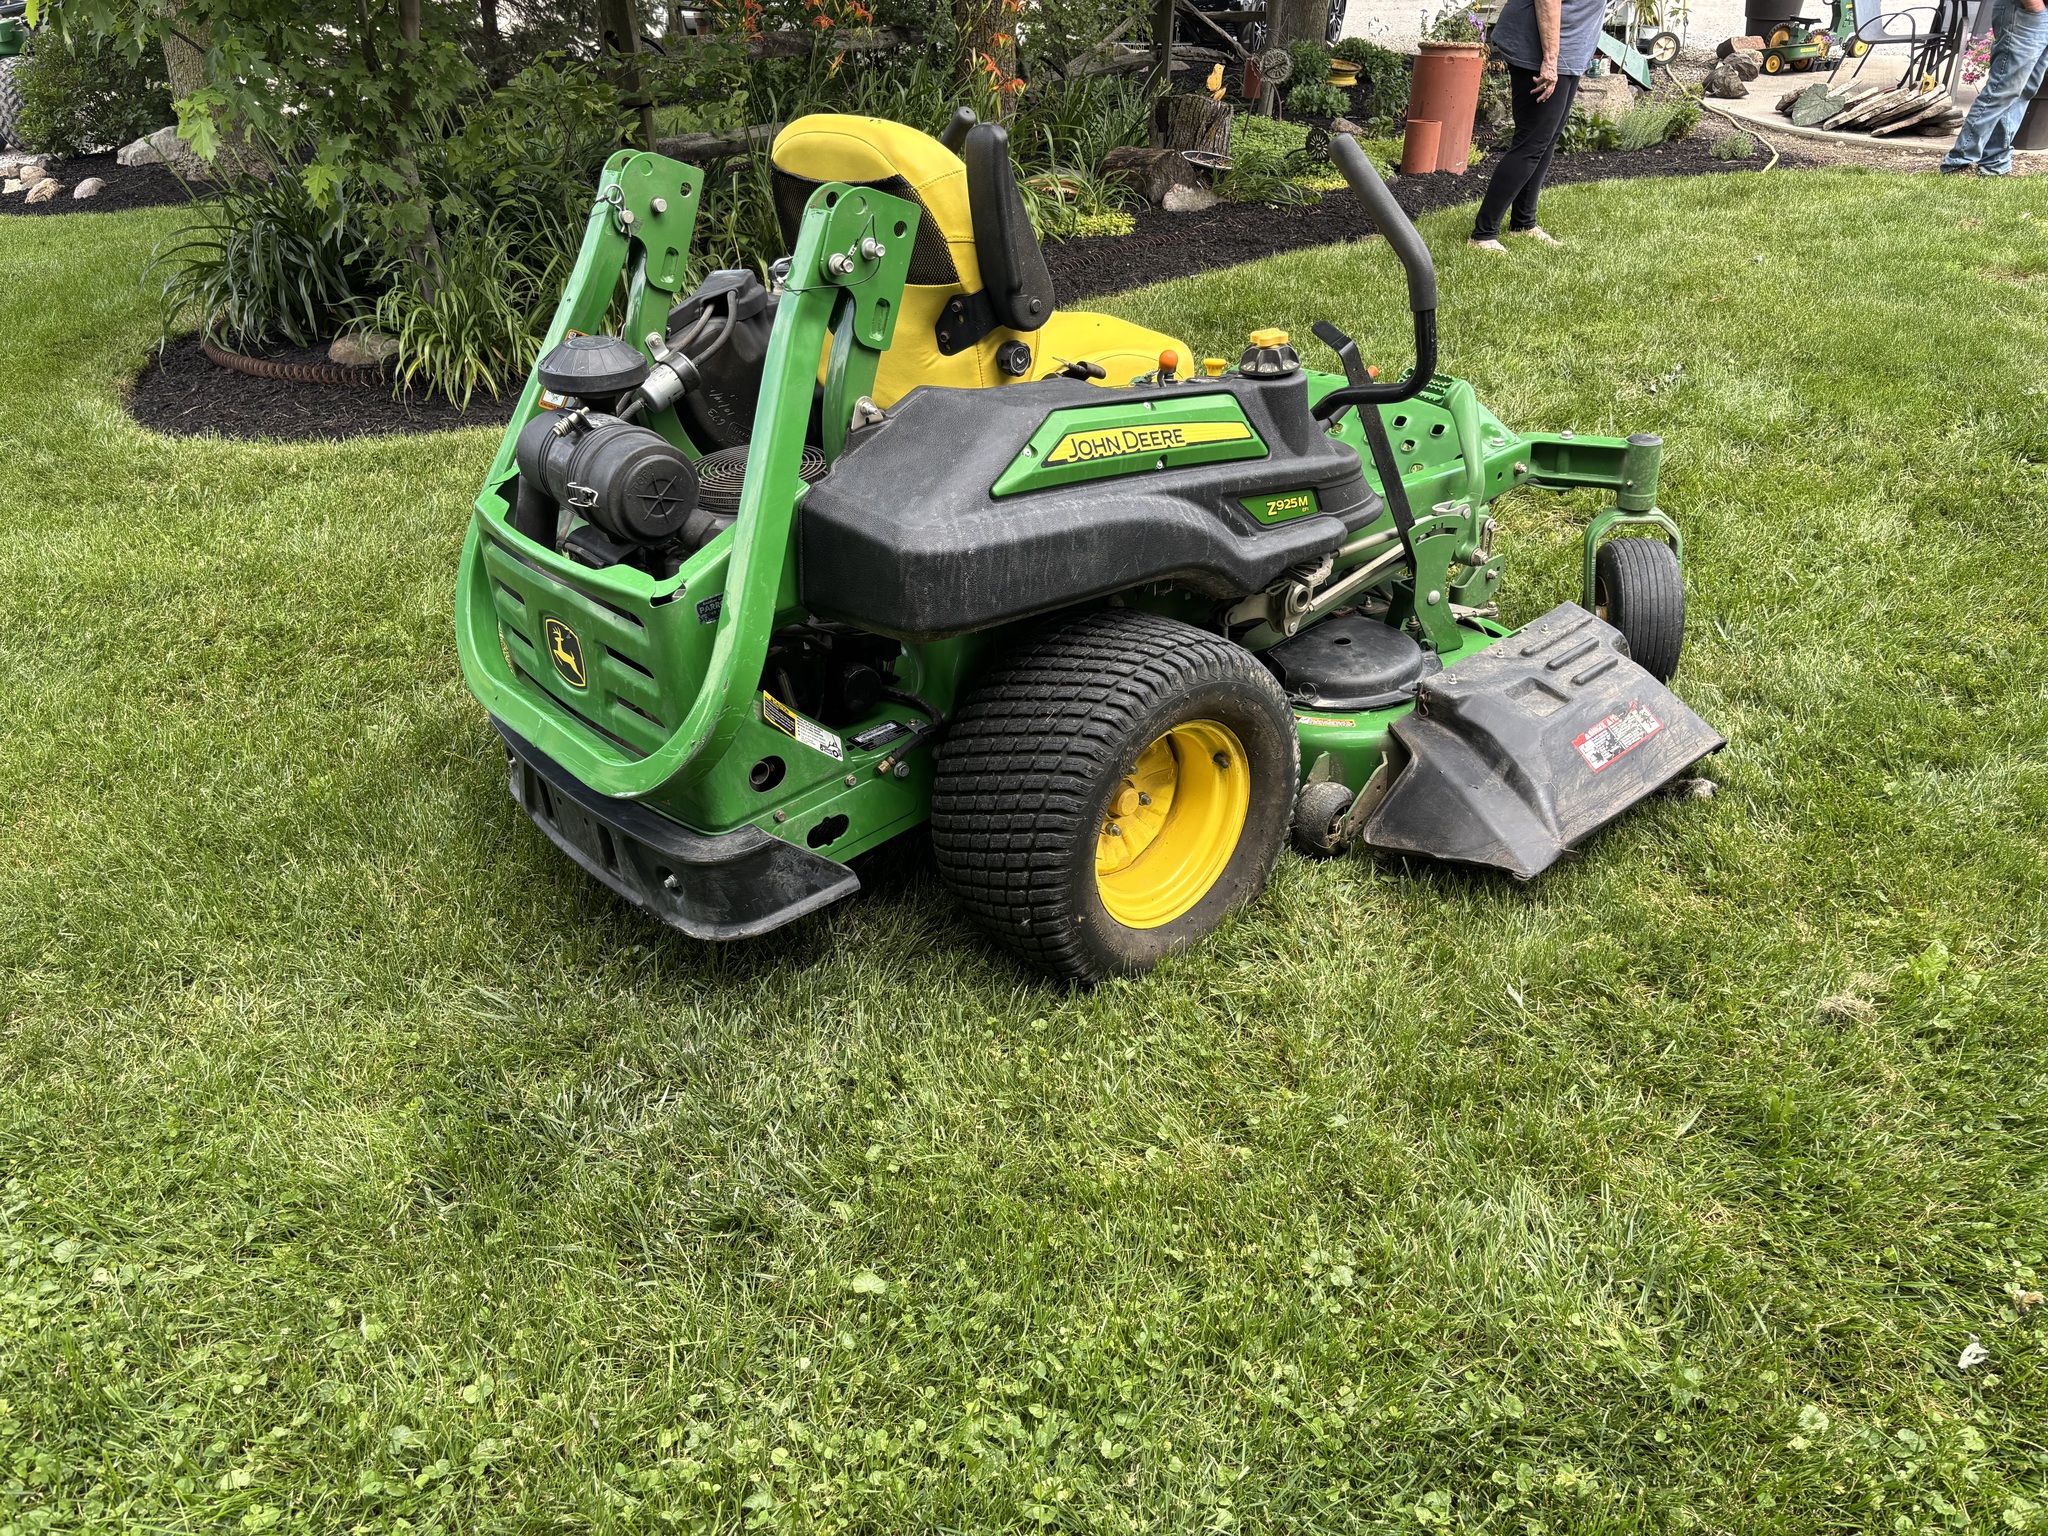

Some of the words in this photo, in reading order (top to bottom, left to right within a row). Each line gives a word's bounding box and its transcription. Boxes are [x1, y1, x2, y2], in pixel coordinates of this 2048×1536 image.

[1068, 436, 1121, 459] JOHN
[1122, 428, 1186, 450] DEERE
[1266, 495, 1308, 516] Z925M
[699, 601, 722, 615] PARR
